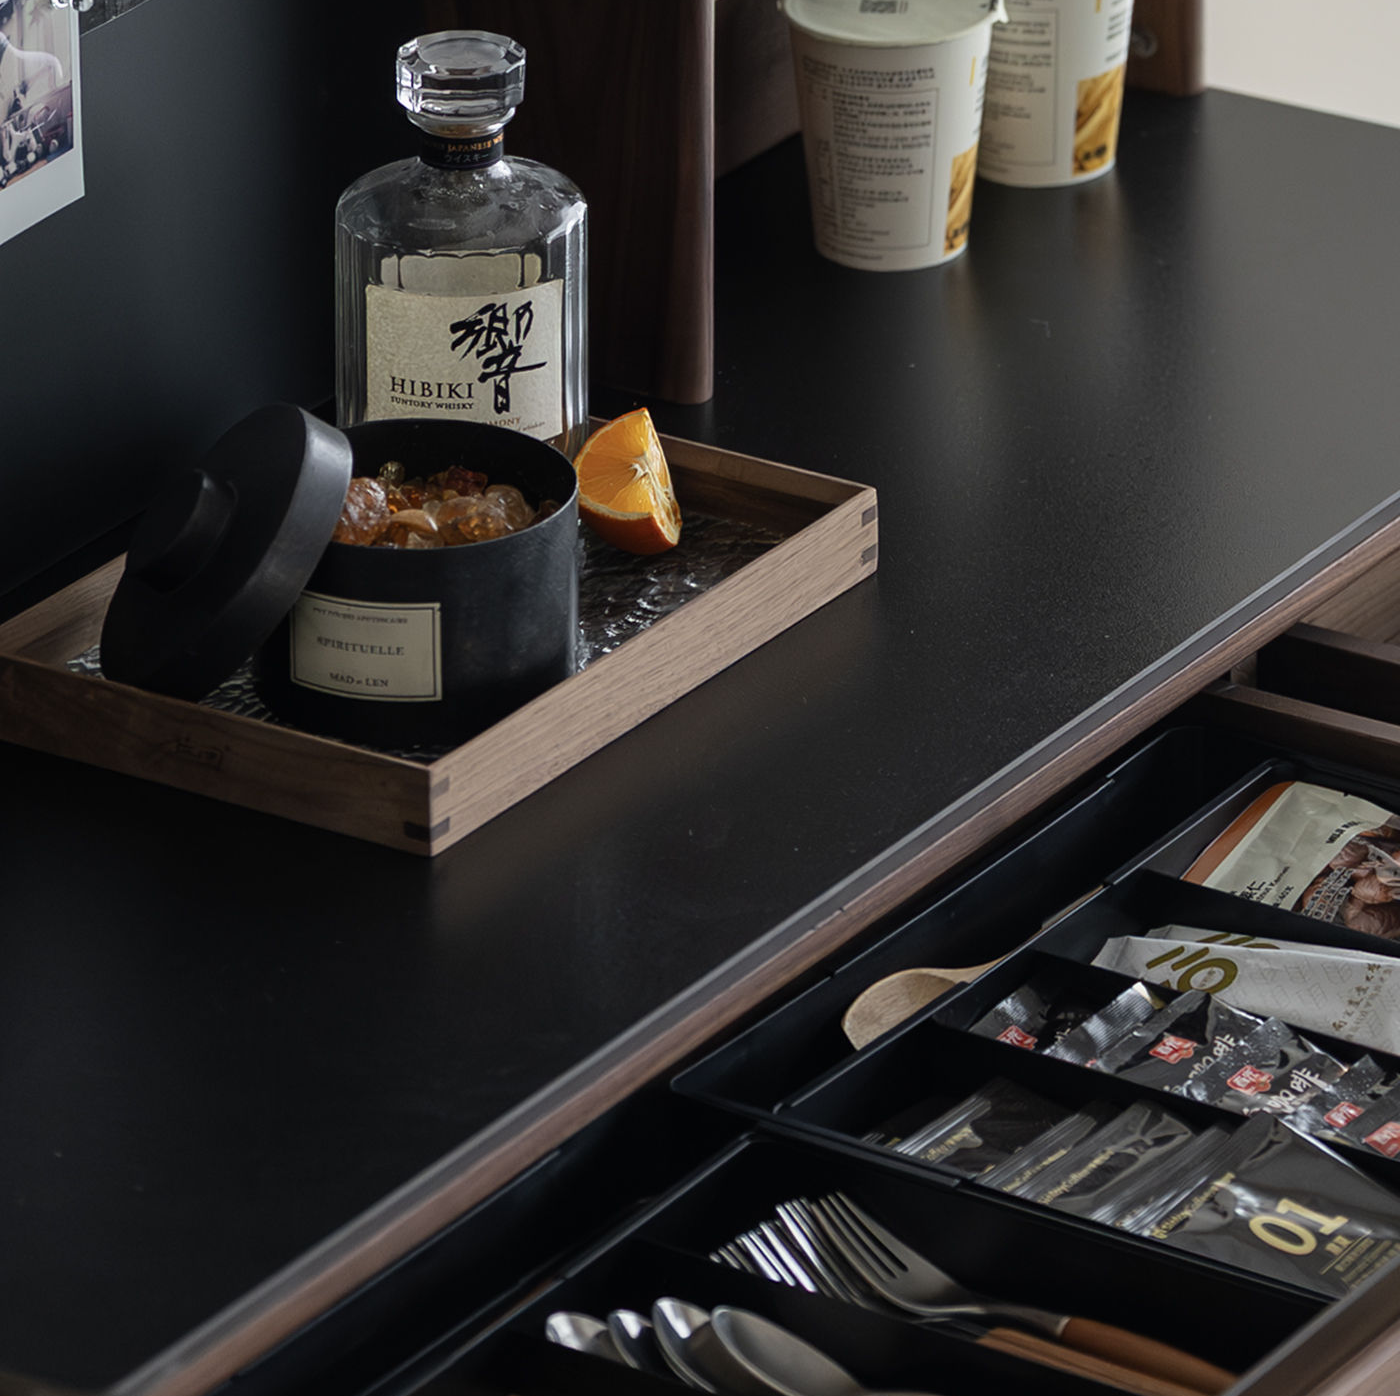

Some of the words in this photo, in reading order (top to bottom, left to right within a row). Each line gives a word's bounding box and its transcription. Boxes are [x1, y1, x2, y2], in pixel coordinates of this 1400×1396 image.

[447, 139, 492, 153] JAPANESE
[449, 300, 547, 415] 響
[389, 376, 475, 400] HIBIKI
[390, 396, 434, 410] SUNTORY
[434, 402, 475, 410] WHISKY
[316, 636, 405, 656] SPIRITUELLE
[329, 672, 354, 685] MAD
[365, 678, 389, 687] LEN
[1248, 1196, 1350, 1257] 01
